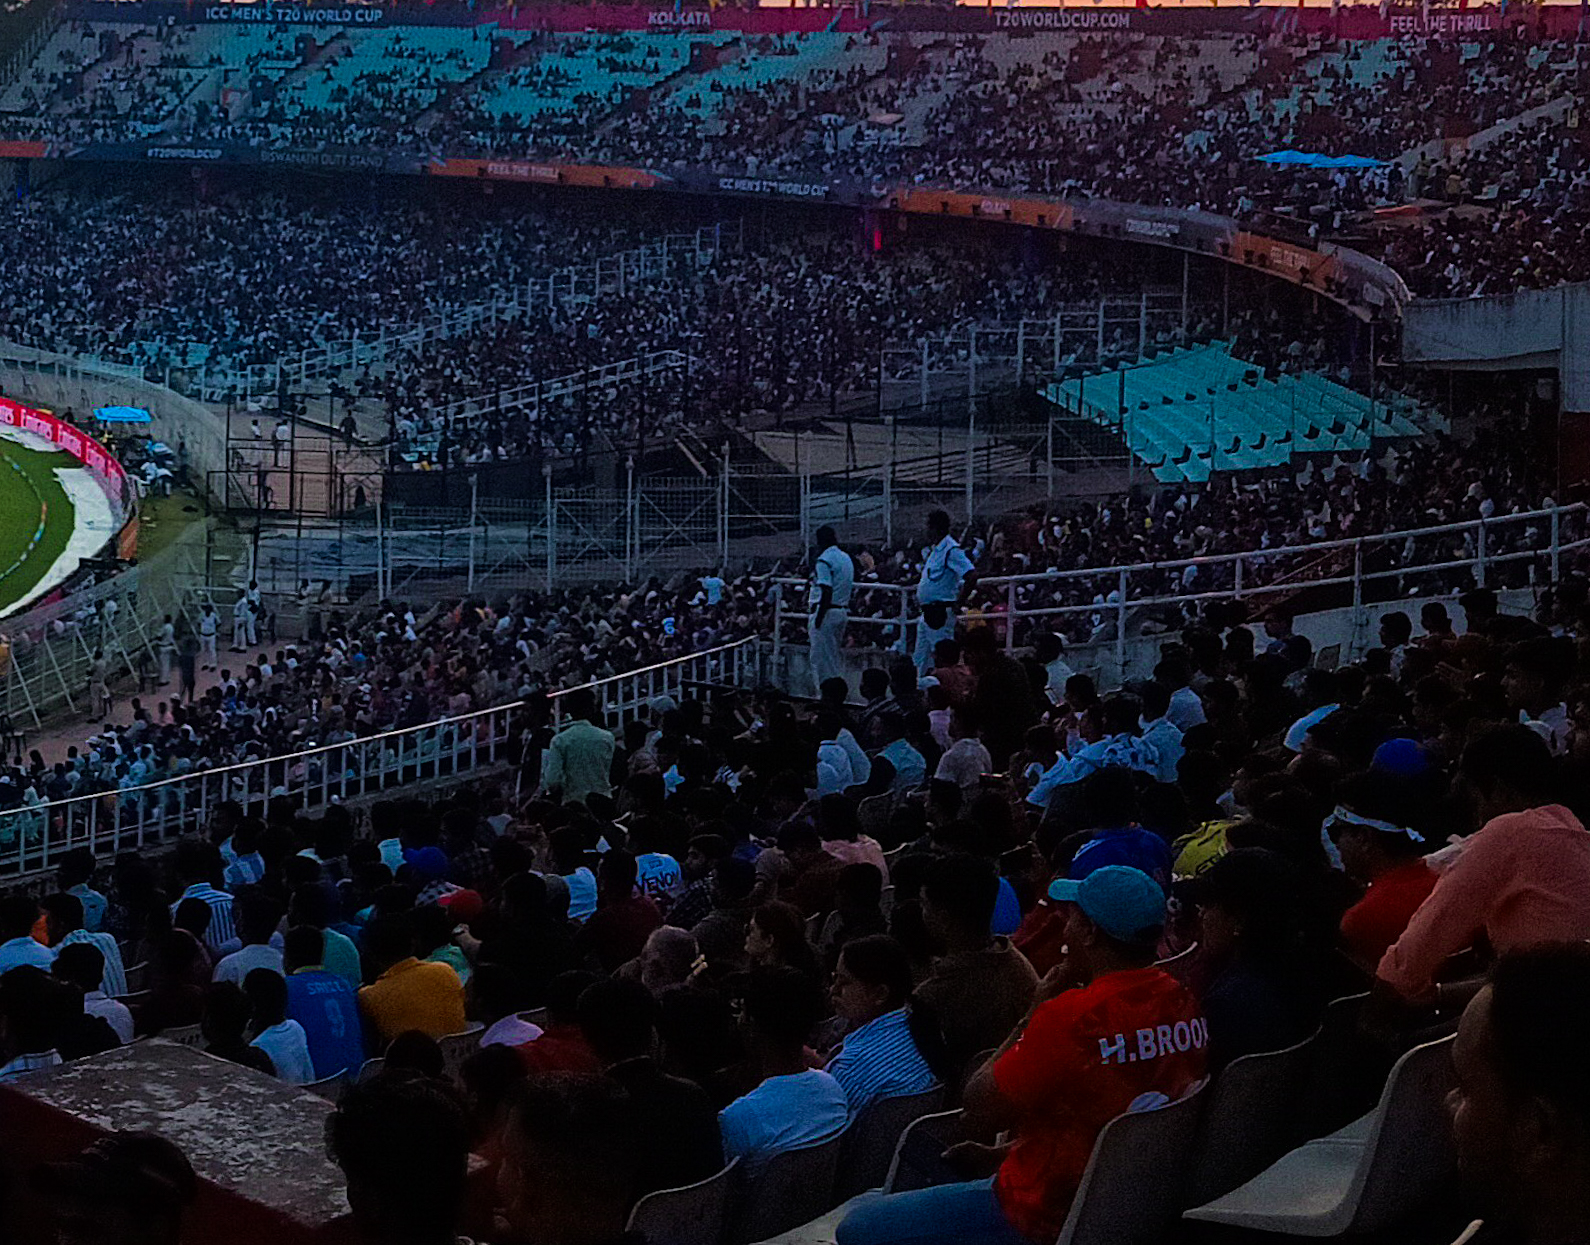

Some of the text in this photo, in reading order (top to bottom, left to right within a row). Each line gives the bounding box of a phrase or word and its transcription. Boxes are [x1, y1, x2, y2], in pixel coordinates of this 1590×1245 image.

[206, 7, 383, 23] ICC MEN'S T20 WORLD CUP
[648, 11, 710, 25] KOLKATA
[994, 11, 1130, 27] T20WORLDCUP.COM
[1390, 15, 1491, 33] FEEL THE THRILL
[20, 409, 53, 441] Emirates
